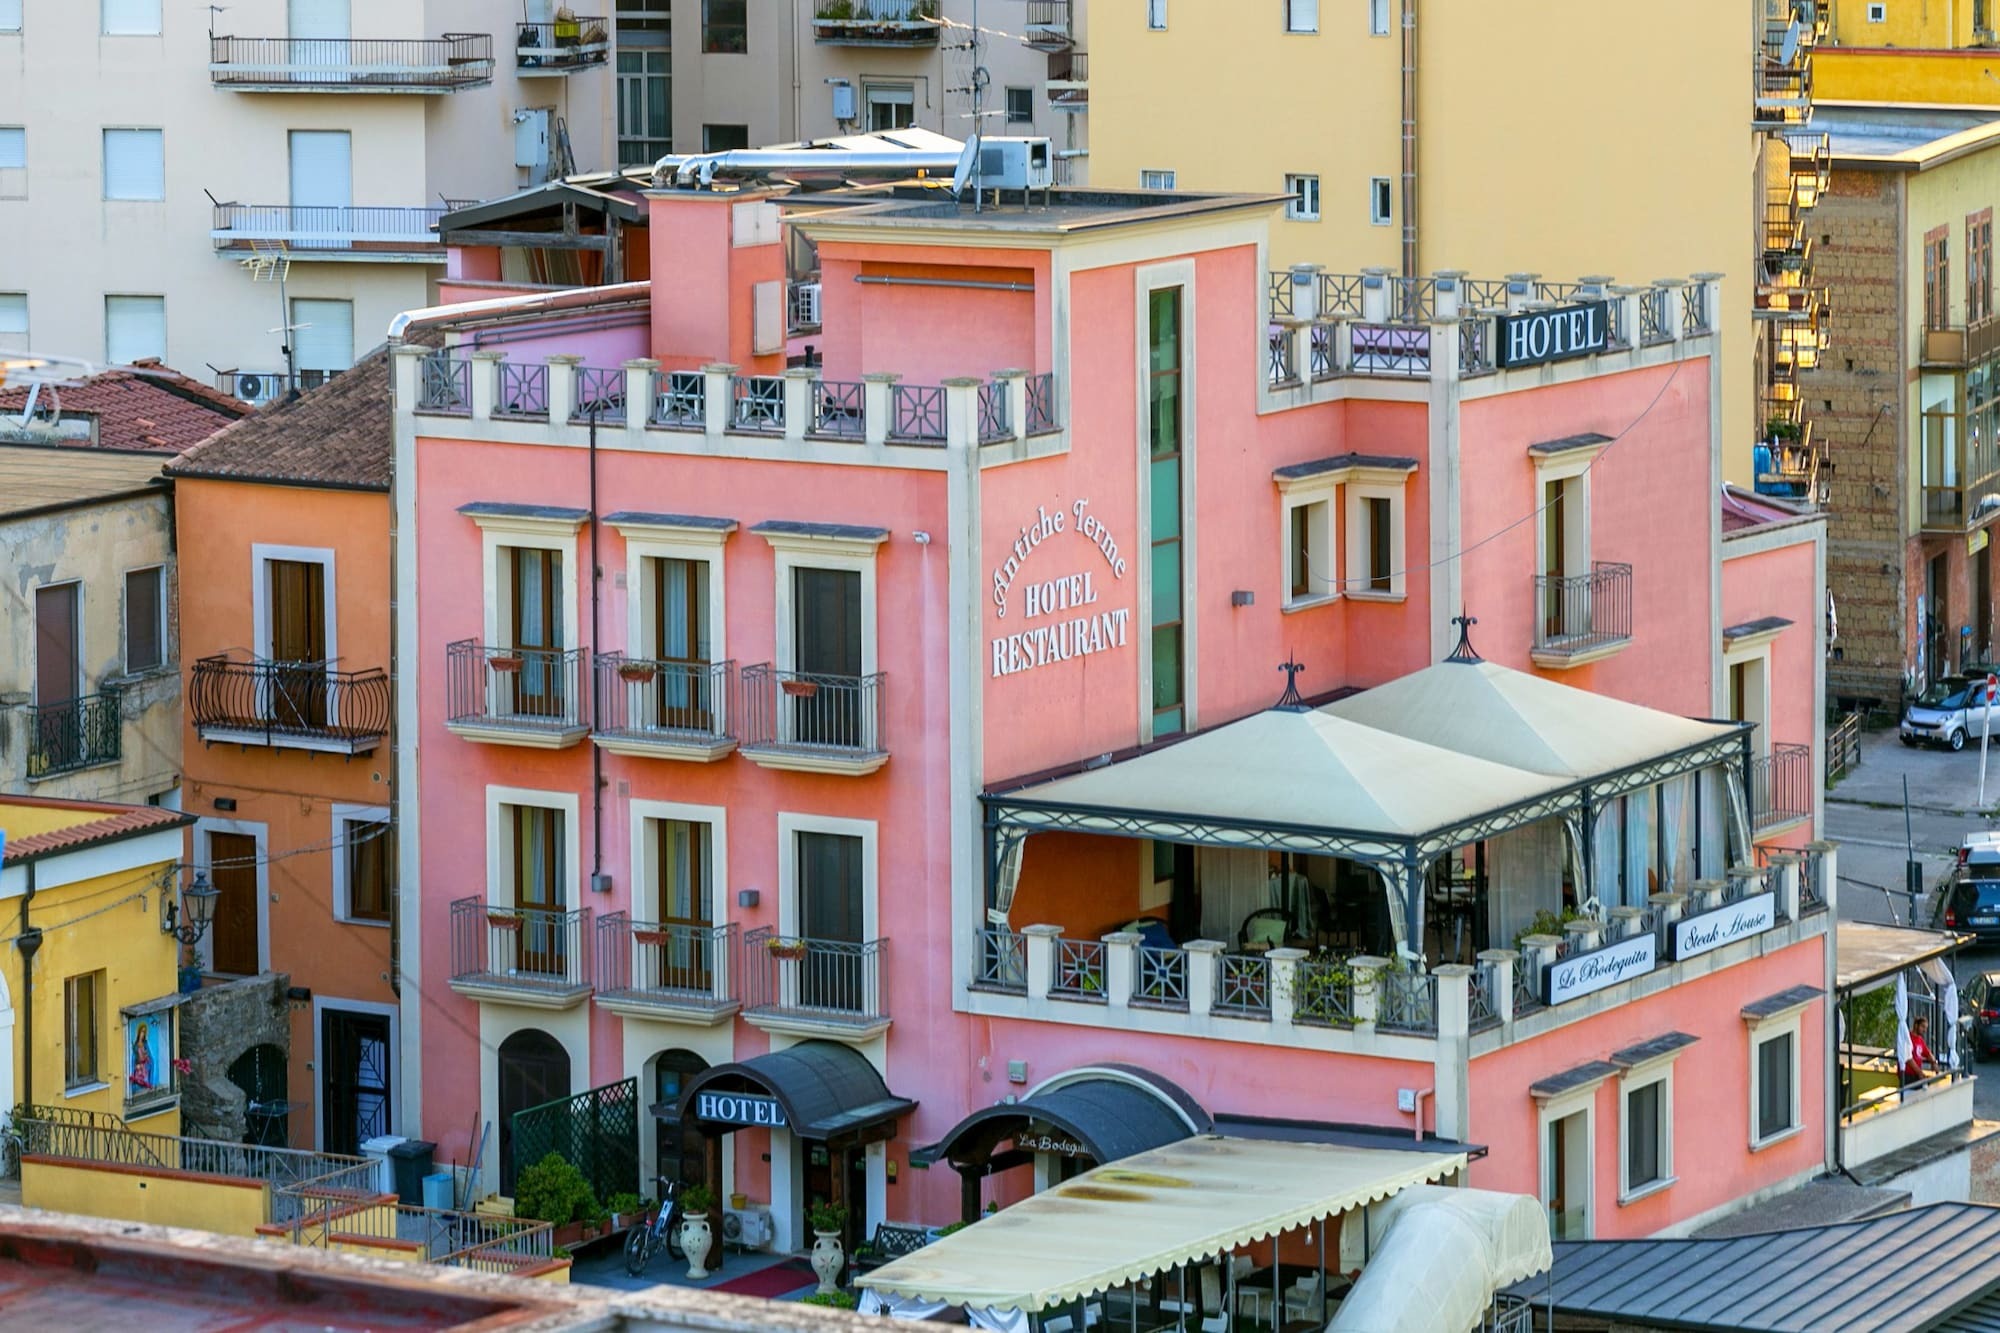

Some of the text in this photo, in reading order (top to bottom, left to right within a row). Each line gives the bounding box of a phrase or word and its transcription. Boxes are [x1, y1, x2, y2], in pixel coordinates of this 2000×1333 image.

[1508, 307, 1604, 362] HOTEL
[993, 498, 1126, 617] Antiche Terme
[1024, 571, 1098, 618] HOTEL
[991, 608, 1129, 678] RESTAURANT
[1684, 912, 1767, 951] Steak House
[1557, 951, 1648, 991] La Bodeguita
[700, 1094, 786, 1126] HOTEL
[1019, 1132, 1037, 1148] La
